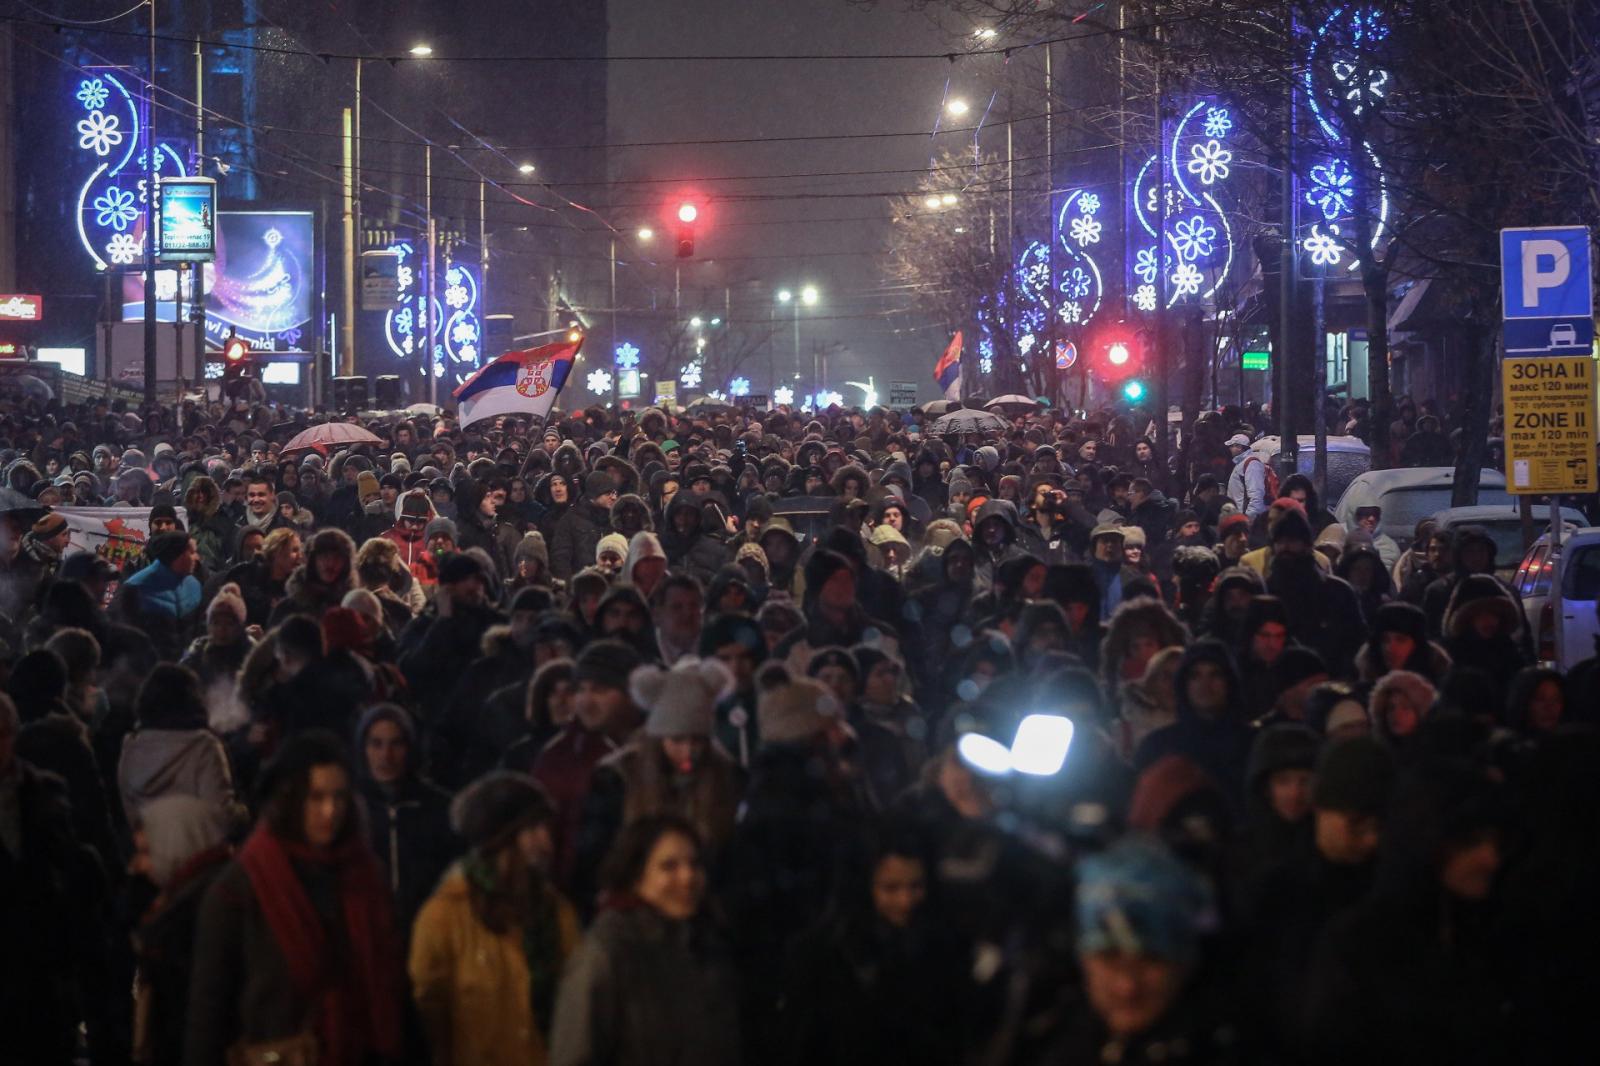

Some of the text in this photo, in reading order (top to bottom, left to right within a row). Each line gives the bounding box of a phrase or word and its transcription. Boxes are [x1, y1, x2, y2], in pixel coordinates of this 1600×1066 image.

[1521, 239, 1571, 308] P
[1511, 362, 1568, 379] ЗОНА
[1509, 381, 1589, 391] макс 120 мин
[1513, 412, 1569, 428] ZONE
[1511, 430, 1589, 440] max 120 min
